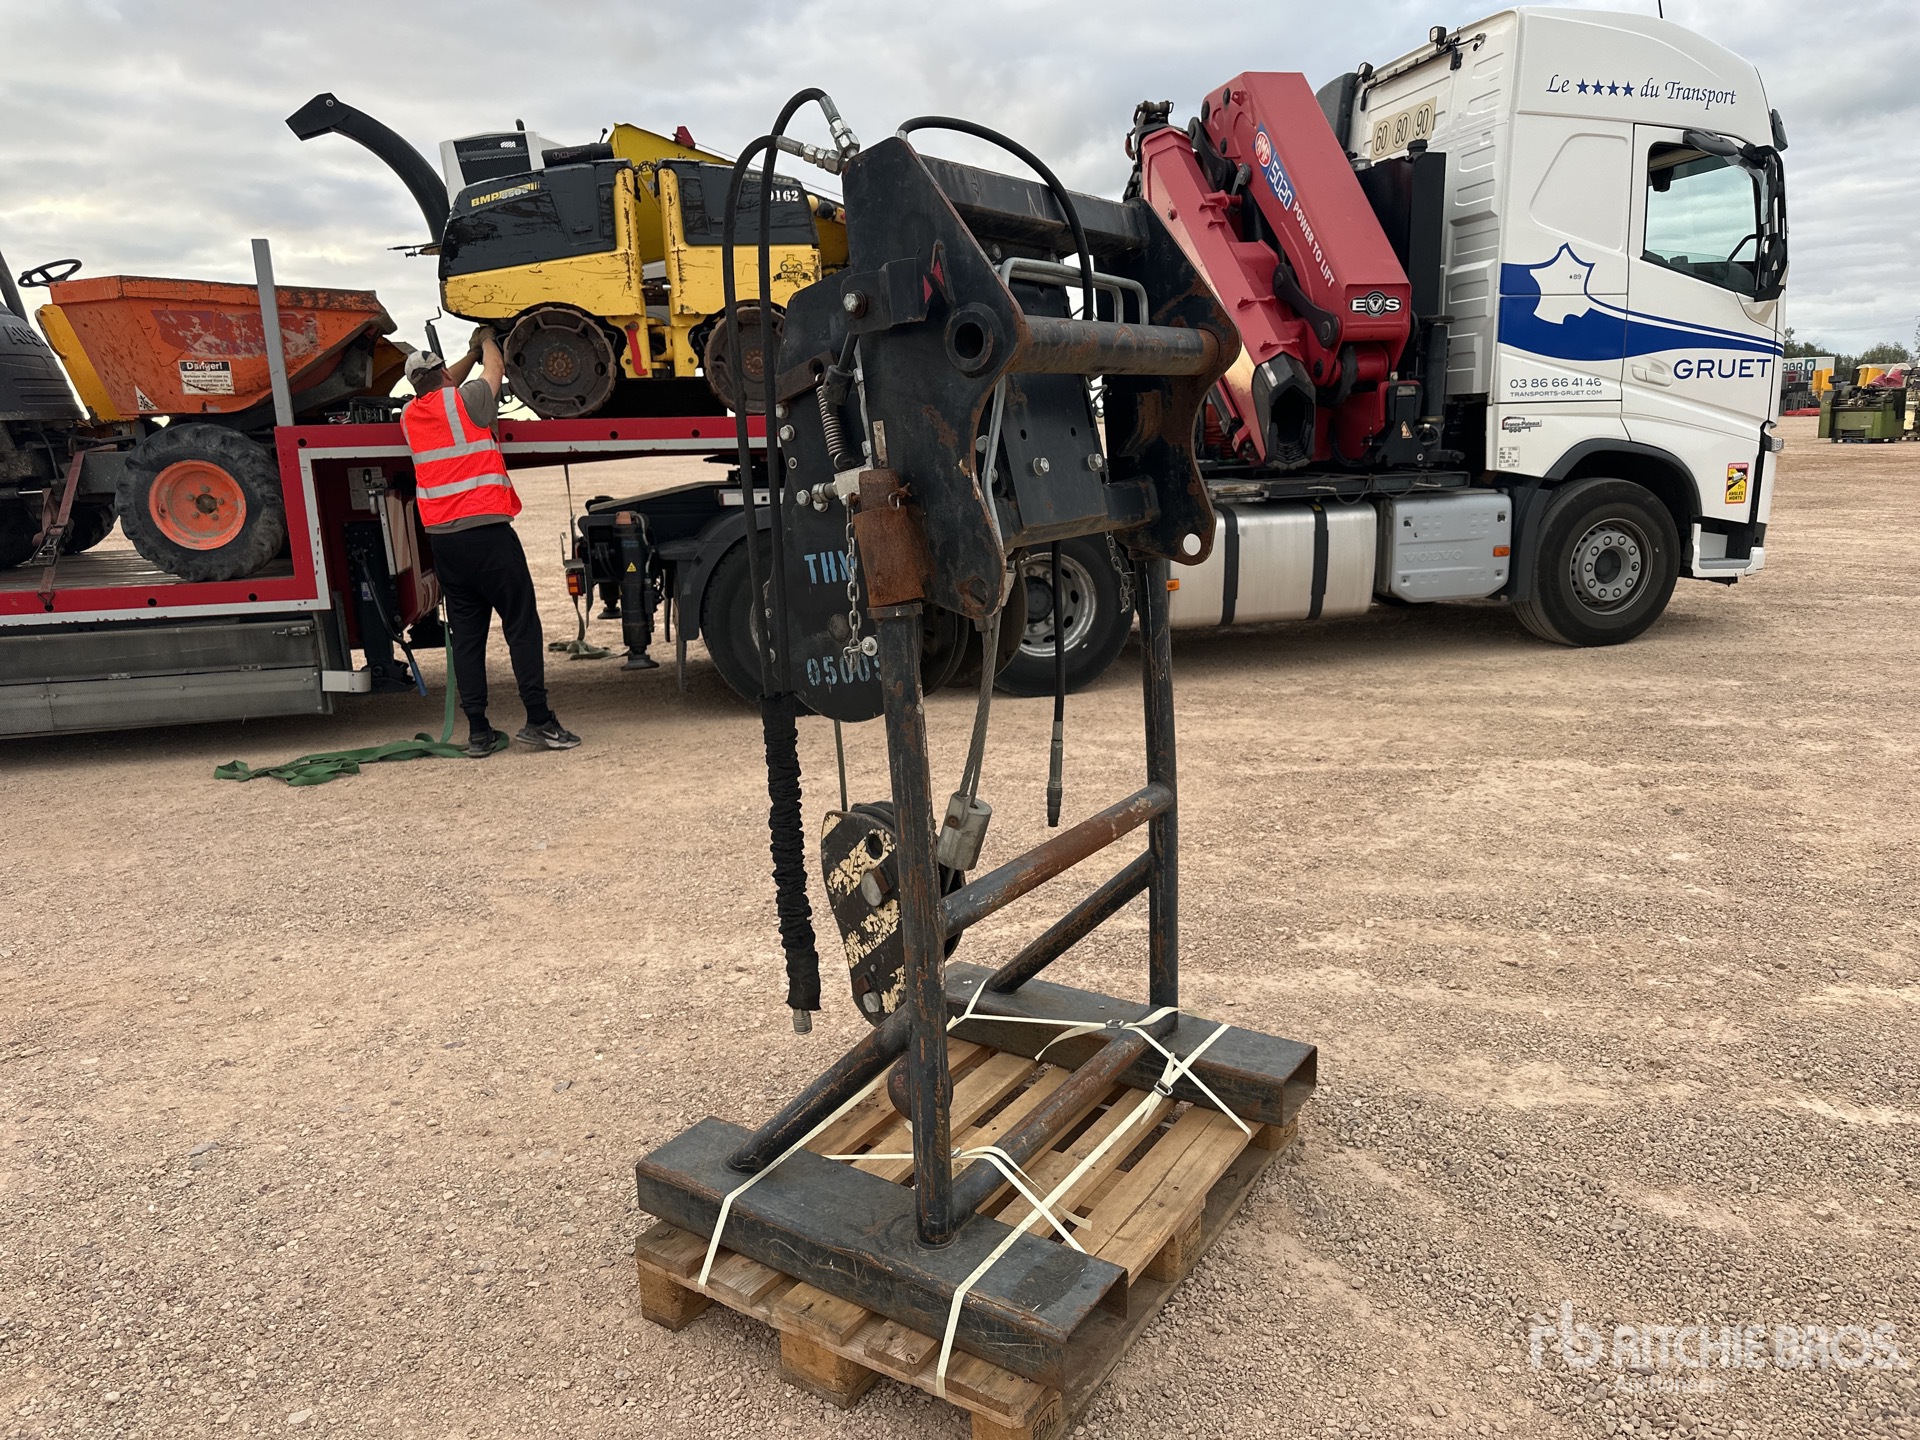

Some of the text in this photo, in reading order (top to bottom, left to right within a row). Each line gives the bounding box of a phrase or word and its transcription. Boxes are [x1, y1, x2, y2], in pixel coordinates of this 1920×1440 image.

[1546, 75, 1736, 110] Le du Transport
[1376, 108, 1428, 151] 60 80 90
[1256, 135, 1271, 163] HMF
[1269, 160, 1293, 211] 5020
[1293, 201, 1335, 287] POWER TO LIFT
[1510, 377, 1602, 388] 03 86 66 41 46
[1673, 358, 1772, 380] GRUET
[1402, 550, 1464, 562] VOLVO
